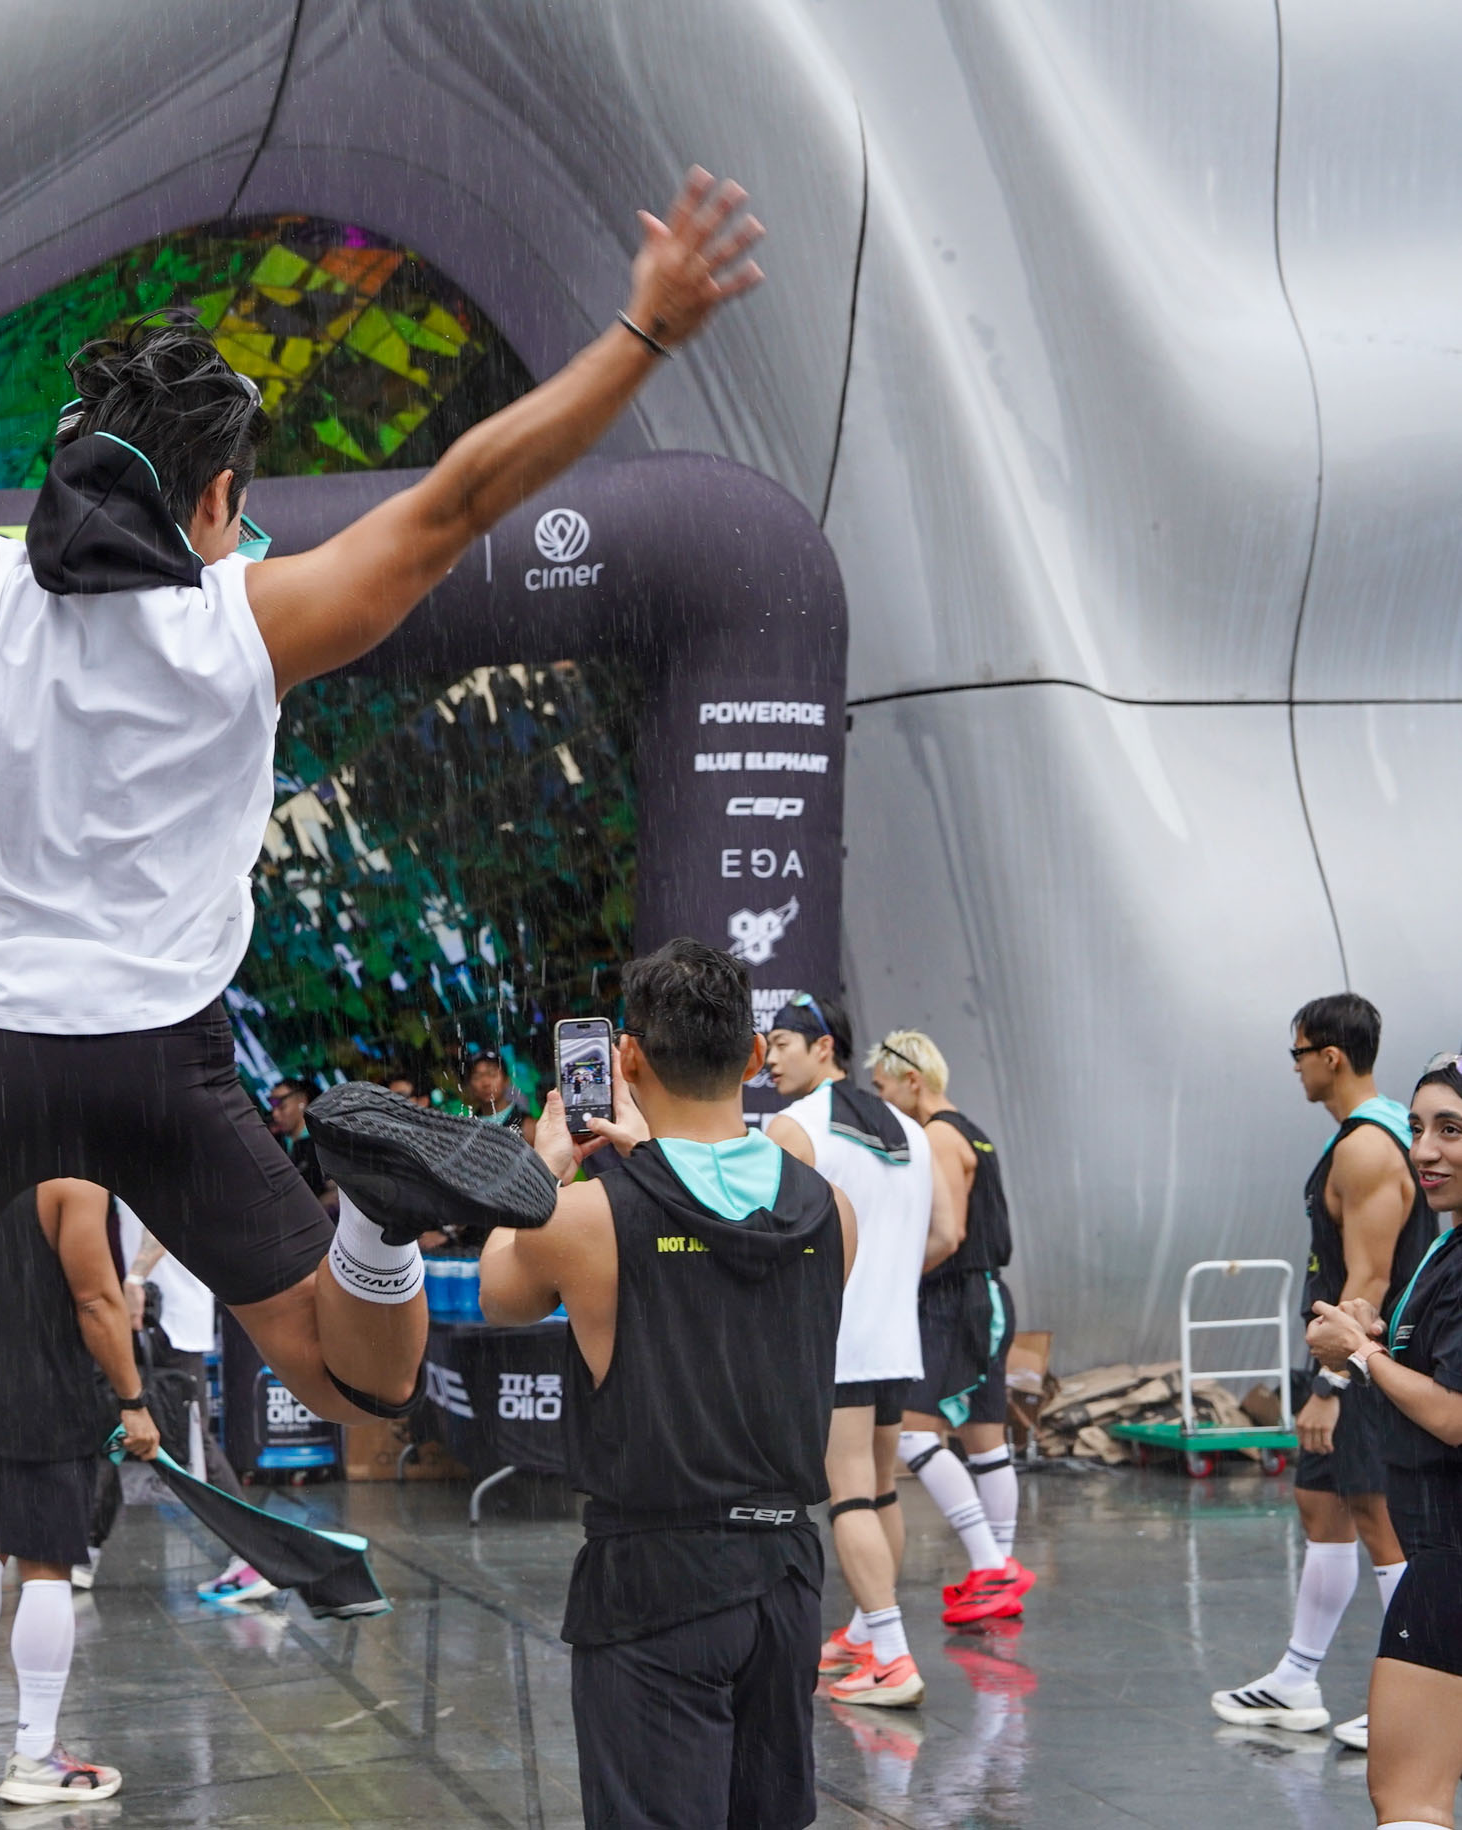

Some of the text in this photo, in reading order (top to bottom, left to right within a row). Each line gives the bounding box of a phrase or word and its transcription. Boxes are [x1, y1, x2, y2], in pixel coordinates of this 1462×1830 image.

[525, 562, 605, 591] cimer
[699, 701, 825, 726] POWERADE
[694, 752, 829, 774] BLUE ELEPHANT
[657, 1237, 686, 1252] NOT
[729, 1506, 796, 1525] cep
